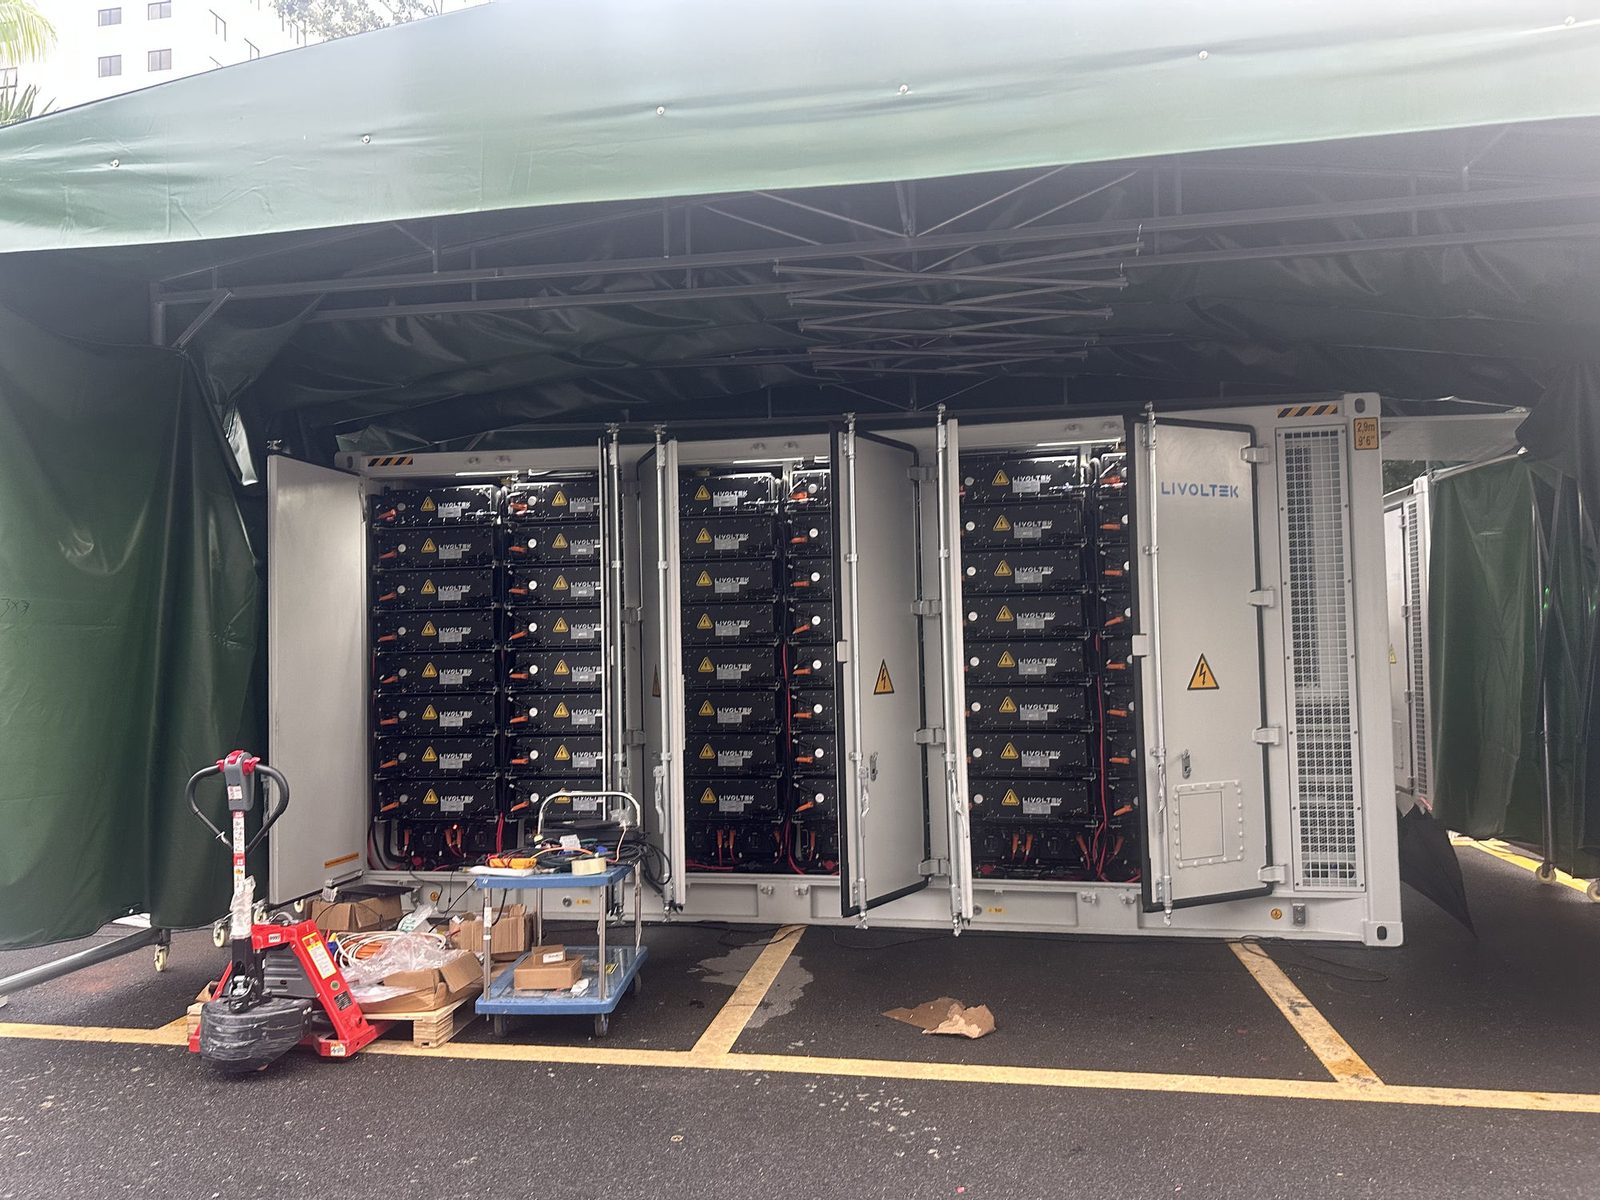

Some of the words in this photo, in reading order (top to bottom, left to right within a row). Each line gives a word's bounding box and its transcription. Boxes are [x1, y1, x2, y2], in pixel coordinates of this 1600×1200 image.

[1012, 474, 1052, 482] LIVOLTEK
[1160, 481, 1240, 498] LIVOLTEK
[713, 490, 748, 498] LIVOLTEK
[438, 501, 471, 509] LIVOLTEK
[714, 533, 749, 541] LIVOLTEK
[438, 543, 472, 551] LIVOLTEK
[438, 584, 471, 592] LIVOLTEK
[1016, 611, 1056, 619] LIVOLTEK
[715, 619, 750, 627] LIVOLTEK
[438, 626, 472, 634] LIVOLTEK
[1018, 657, 1057, 665] LIVOLTEK
[439, 668, 473, 676] LIVOLTEK
[717, 706, 752, 714] LIVOLTEK
[1019, 703, 1059, 711] LIVOLTEK
[439, 710, 473, 718] LIVOLTEK
[439, 752, 473, 760] LIVOLTEK
[1021, 750, 1061, 758] LIVOLTEK
[718, 794, 754, 802] LIVOLTEK
